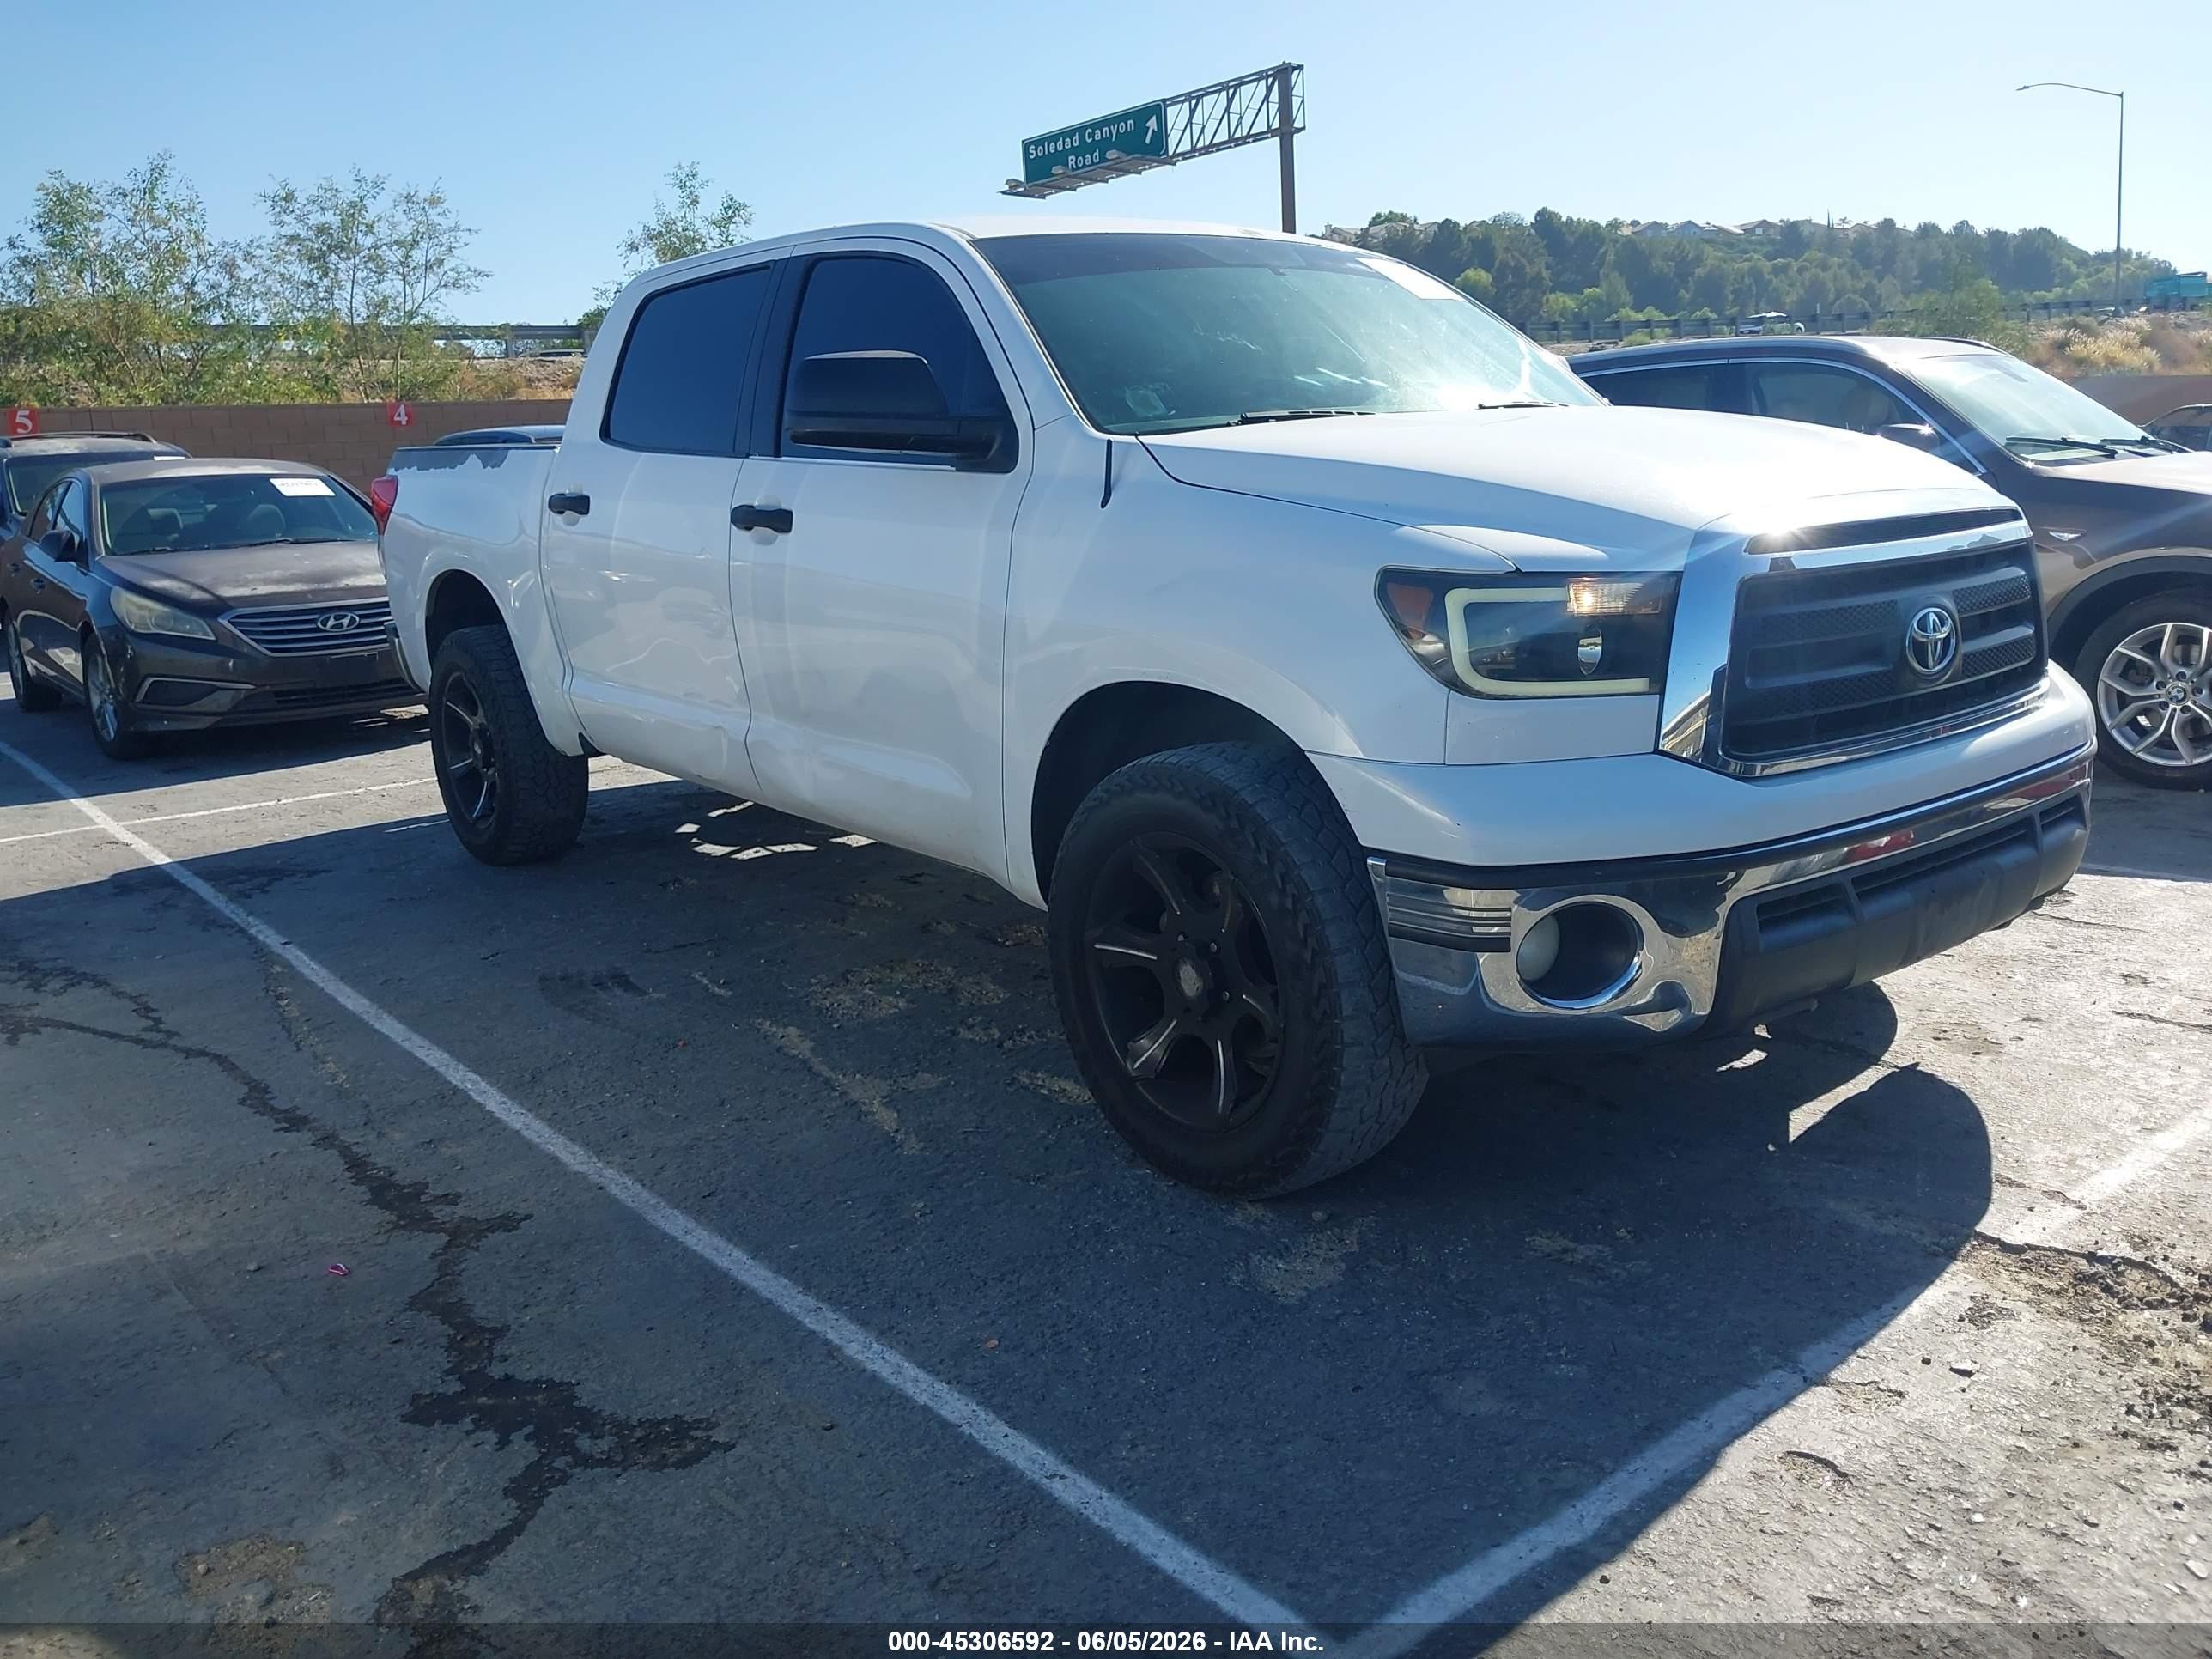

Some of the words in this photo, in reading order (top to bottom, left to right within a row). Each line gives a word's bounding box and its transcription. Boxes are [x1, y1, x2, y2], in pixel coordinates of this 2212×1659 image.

[1029, 133, 1079, 159] Soledad
[1085, 119, 1134, 143] Canyon
[1068, 149, 1099, 170] Road
[15, 410, 33, 433] 5
[393, 404, 408, 426] 4
